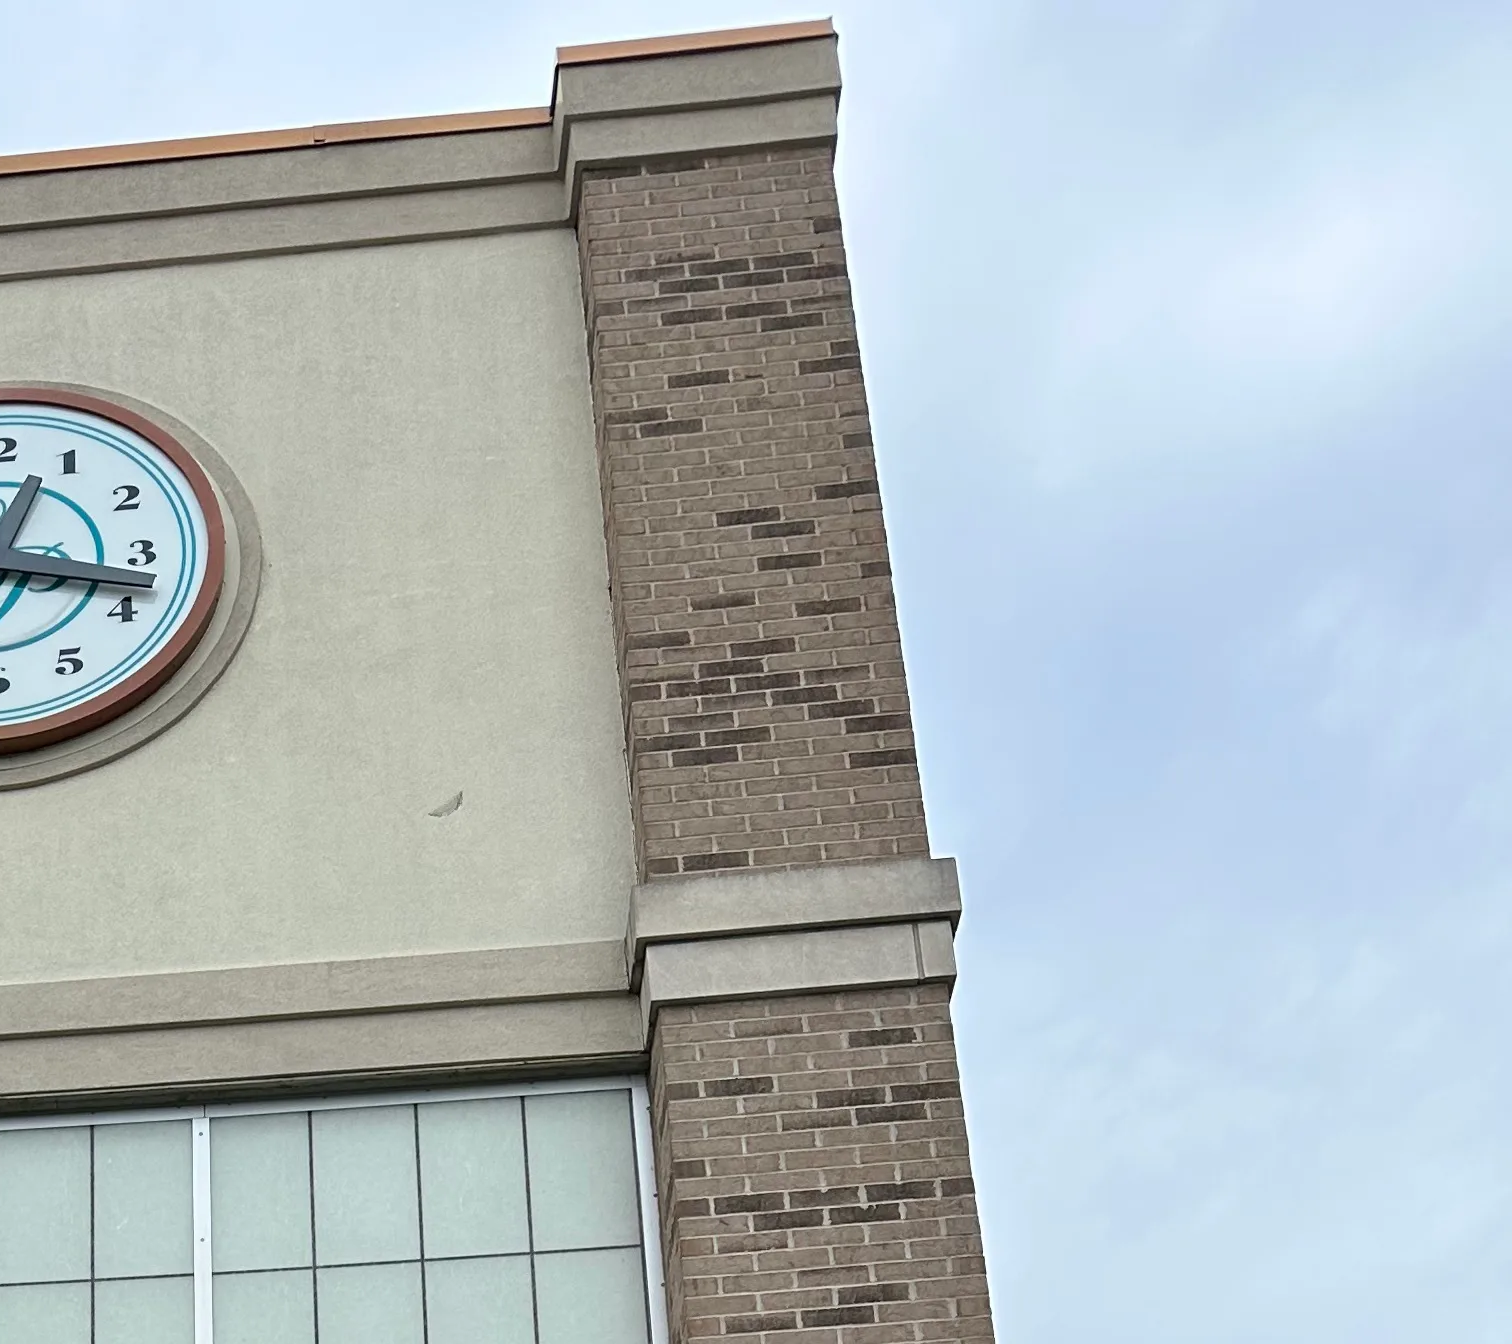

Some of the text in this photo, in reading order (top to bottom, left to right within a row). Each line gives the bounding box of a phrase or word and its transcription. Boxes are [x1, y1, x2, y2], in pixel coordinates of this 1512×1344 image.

[58, 449, 78, 475] 1
[113, 485, 141, 511] 2
[127, 540, 156, 566] 3
[107, 596, 139, 624] 4
[55, 647, 84, 675] 5
